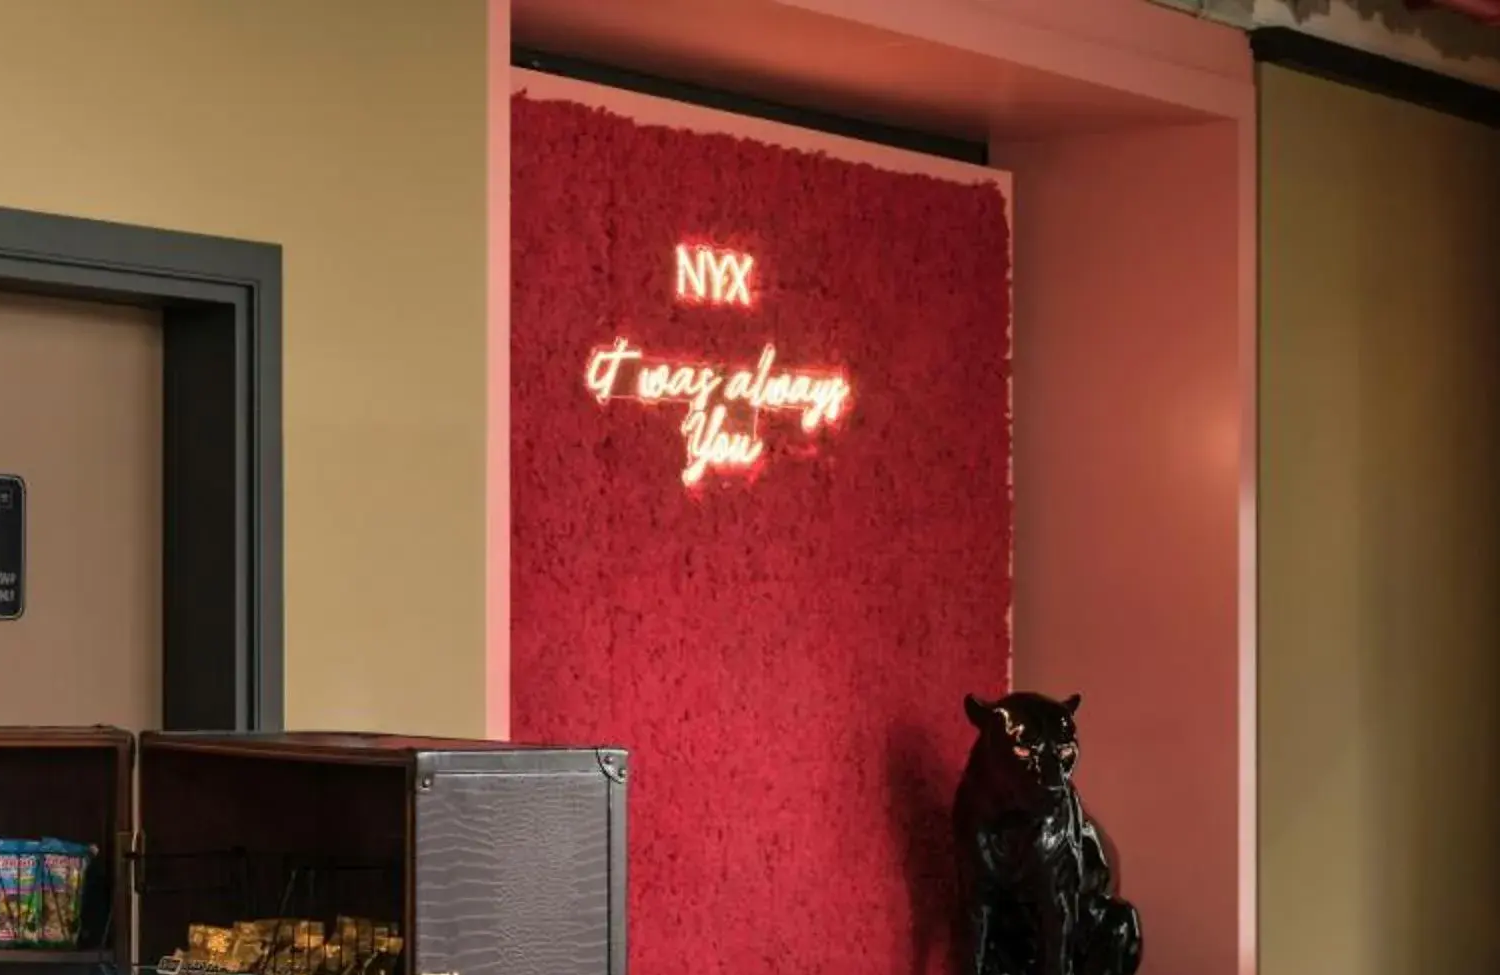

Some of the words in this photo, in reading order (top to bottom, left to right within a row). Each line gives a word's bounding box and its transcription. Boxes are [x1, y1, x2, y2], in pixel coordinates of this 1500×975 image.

[675, 243, 754, 306] NYX
[723, 342, 851, 432] always
[681, 403, 763, 485] You
